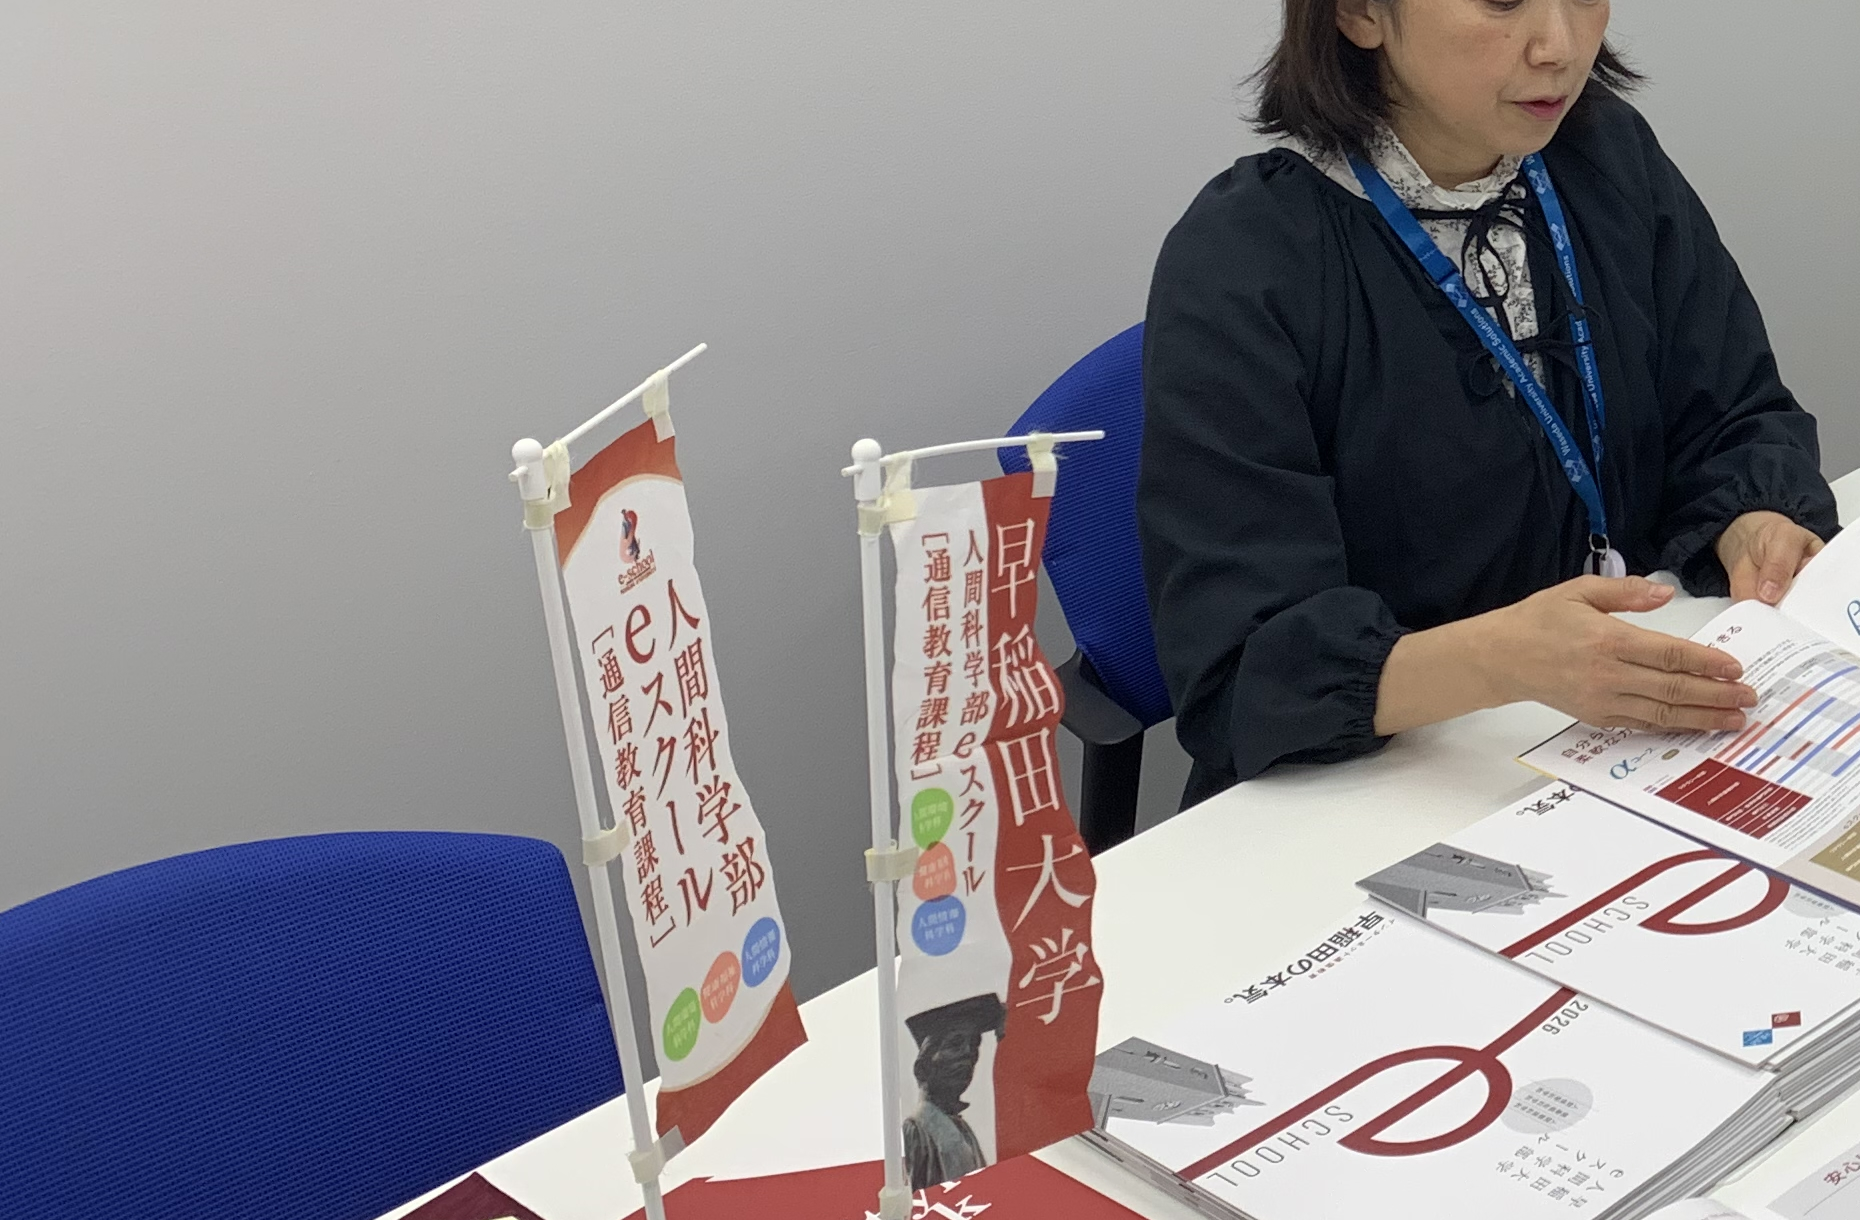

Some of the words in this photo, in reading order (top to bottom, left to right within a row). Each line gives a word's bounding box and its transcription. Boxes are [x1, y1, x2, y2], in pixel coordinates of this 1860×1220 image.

[1470, 308, 1502, 348] Solutions
[1499, 345, 1528, 384] Academic
[1527, 383, 1554, 426] University
[1552, 423, 1571, 457] Waseda
[952, 529, 991, 897] 人間科学部eスクール
[625, 604, 714, 927] eスクール
[667, 579, 765, 917] 人間科学部
[991, 518, 1100, 1025] 早稲田大学
[1524, 894, 1650, 965] SCHOOL
[1223, 910, 1385, 1005] 早稲田の本気。
[1541, 999, 1589, 1036] 2026
[1207, 1104, 1354, 1188] SCHOOL
[1514, 1145, 1605, 1192] 人間科学部
[1537, 1132, 1625, 1179] eスクール
[1495, 1160, 1588, 1208] 早稲田大学
